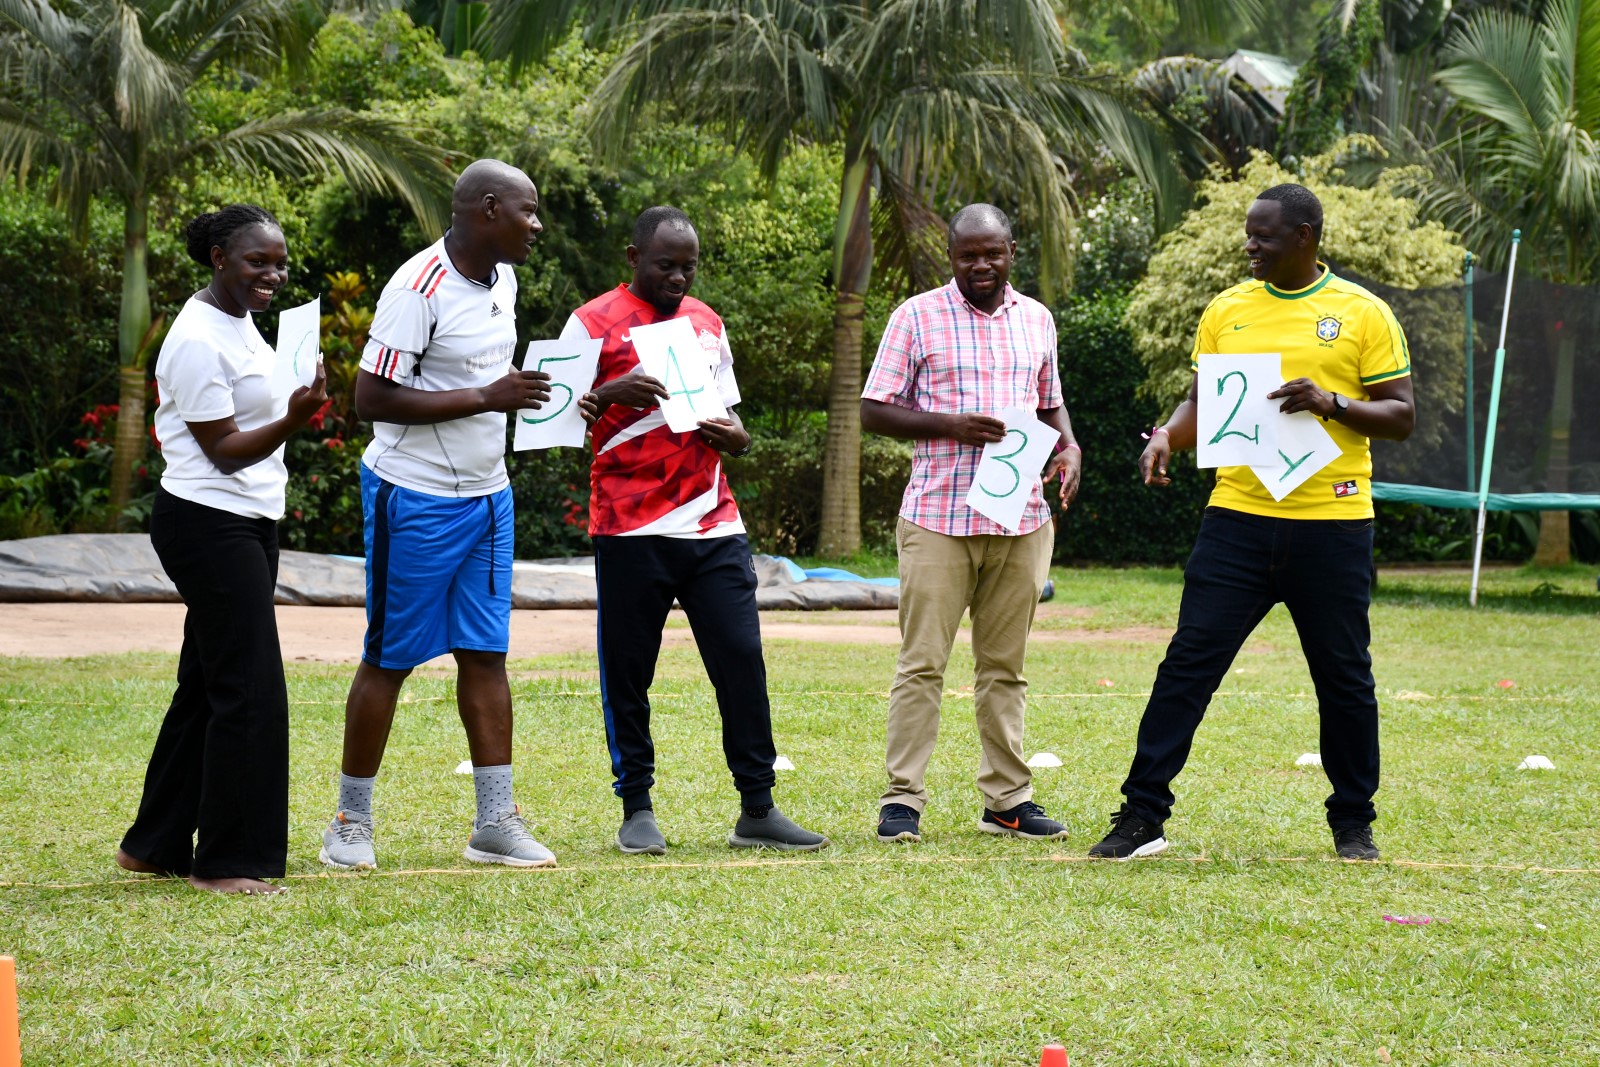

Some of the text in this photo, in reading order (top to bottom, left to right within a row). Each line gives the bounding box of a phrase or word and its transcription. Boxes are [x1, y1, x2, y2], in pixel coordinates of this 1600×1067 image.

[521, 354, 581, 425] 5
[1208, 370, 1260, 446] 2
[978, 428, 1029, 498] 3
